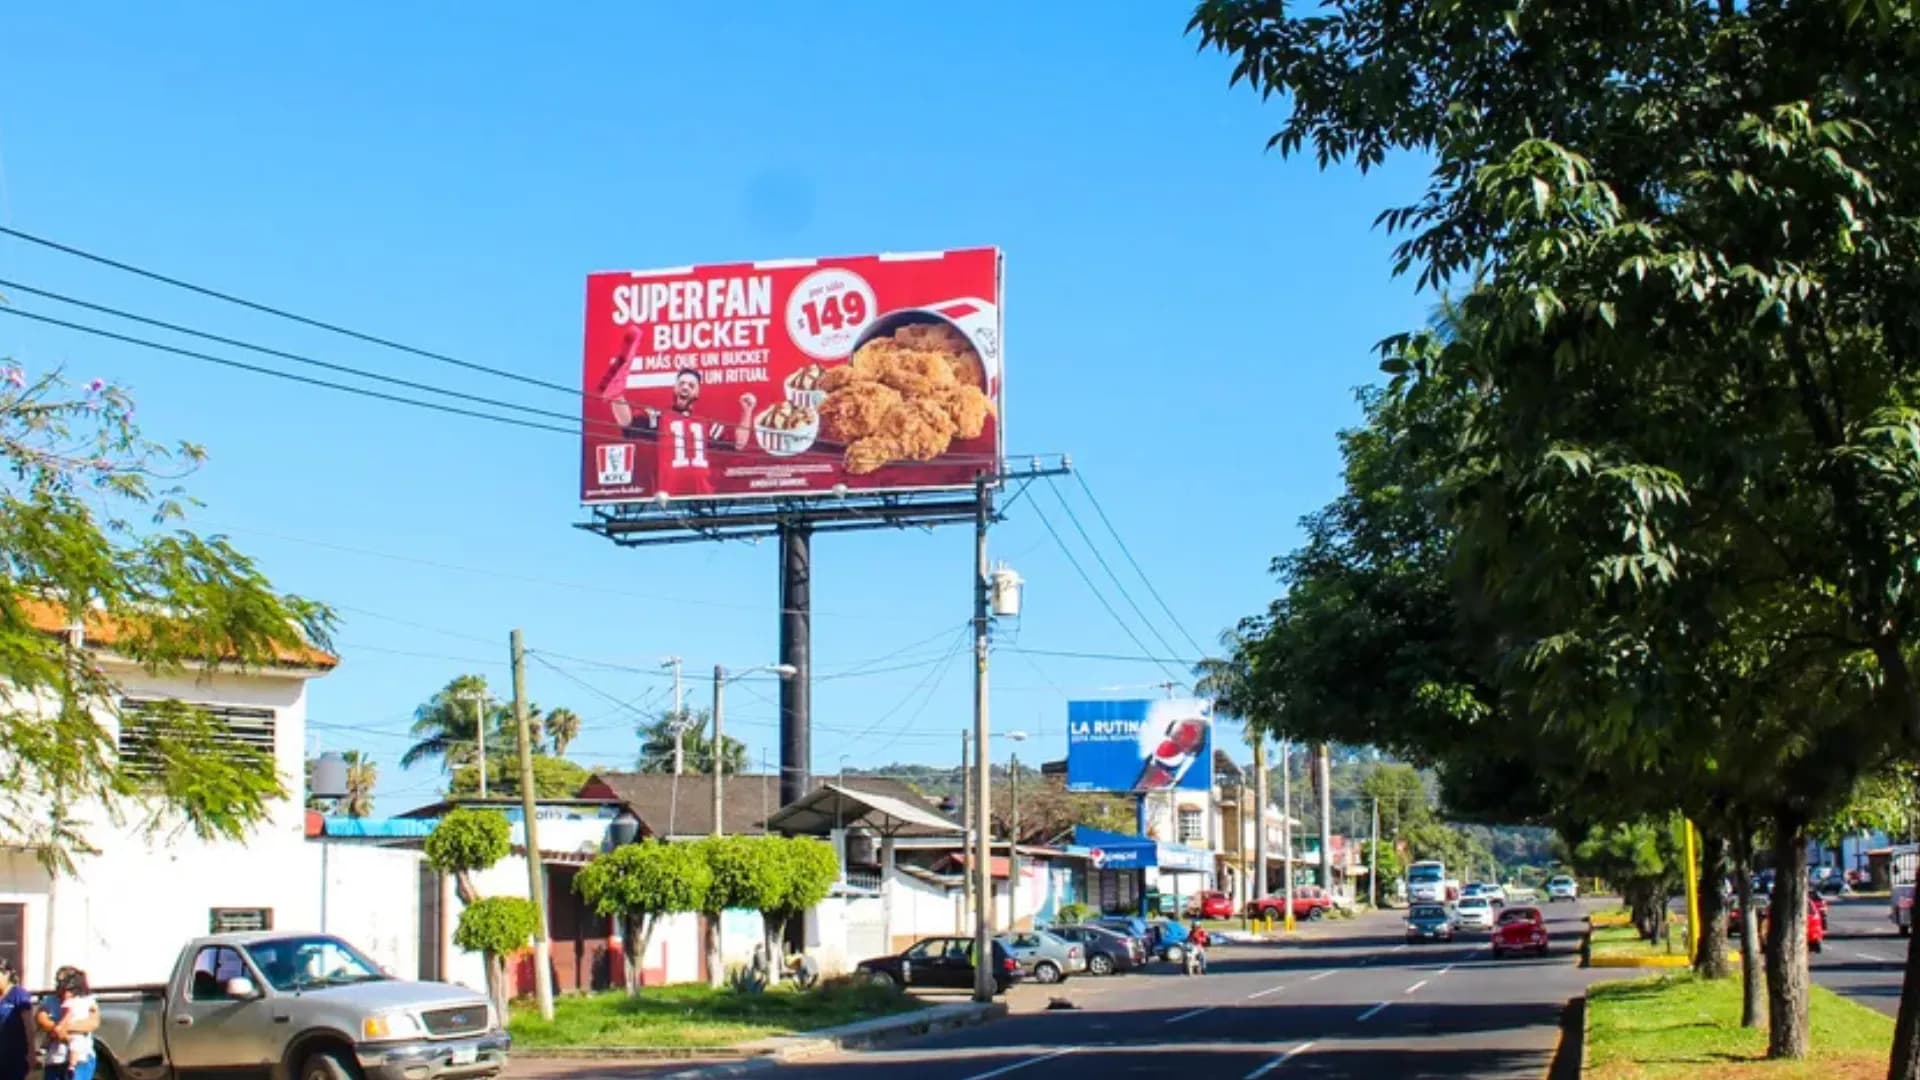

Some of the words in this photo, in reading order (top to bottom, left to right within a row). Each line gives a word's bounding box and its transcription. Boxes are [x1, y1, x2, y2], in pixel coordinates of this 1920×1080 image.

[706, 275, 772, 319] FAN
[797, 290, 867, 337] $149
[653, 318, 770, 352] BUCKET
[645, 350, 671, 370] MÁS
[673, 352, 699, 370] QUE
[700, 351, 720, 367] UN
[721, 349, 770, 366] BUCKET
[704, 369, 723, 385] UN
[725, 367, 769, 383] RITUAL
[669, 420, 709, 469] 11
[603, 473, 625, 482] KFC
[1071, 721, 1090, 735] LA
